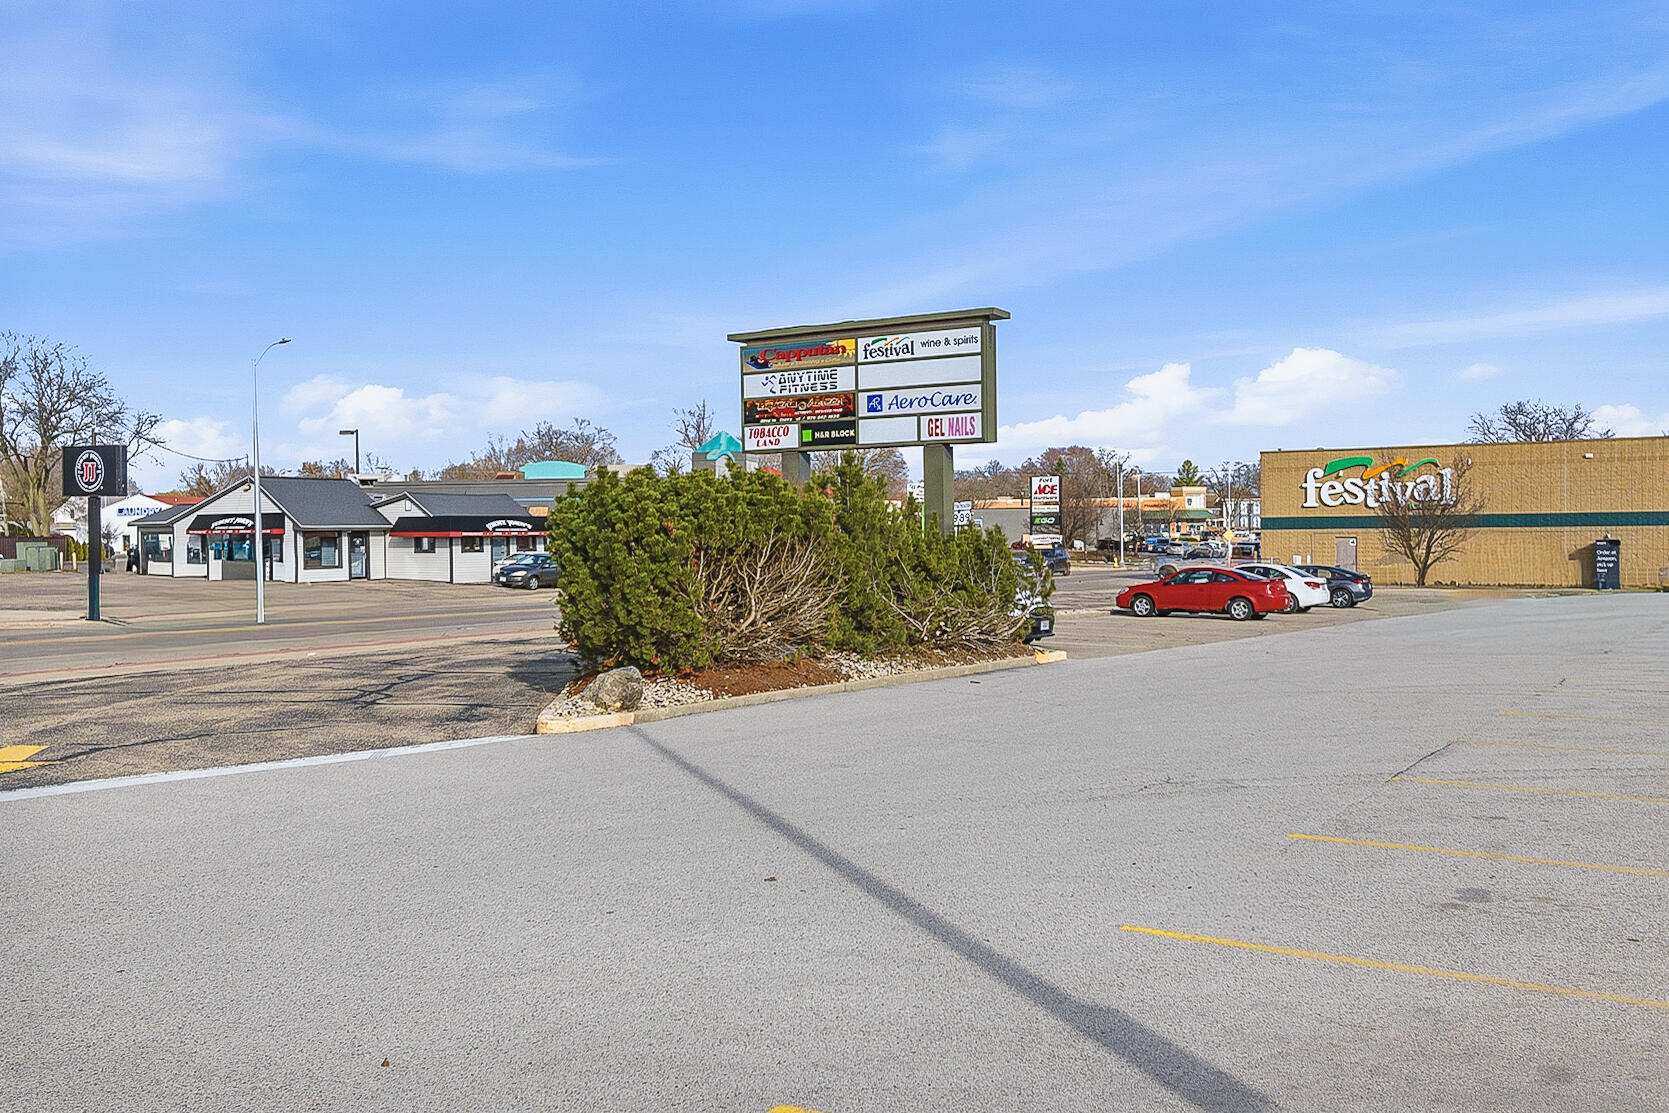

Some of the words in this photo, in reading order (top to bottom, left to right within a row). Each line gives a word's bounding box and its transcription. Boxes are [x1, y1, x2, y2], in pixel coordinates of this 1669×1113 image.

[863, 340, 915, 360] festival
[920, 338, 942, 348] wine
[944, 337, 951, 346] &
[953, 335, 979, 347] spirits
[778, 369, 838, 385] ANYTIME
[779, 381, 838, 394] FITNESS
[887, 391, 977, 411] AeroCare
[748, 425, 790, 440] TOBACCO
[814, 431, 830, 439] H&R
[830, 429, 855, 438] BLOCK
[927, 418, 945, 438] GEL
[948, 416, 976, 437] NAILS
[756, 439, 781, 448] LAND
[1033, 484, 1058, 495] ACE
[1301, 467, 1456, 509] festival
